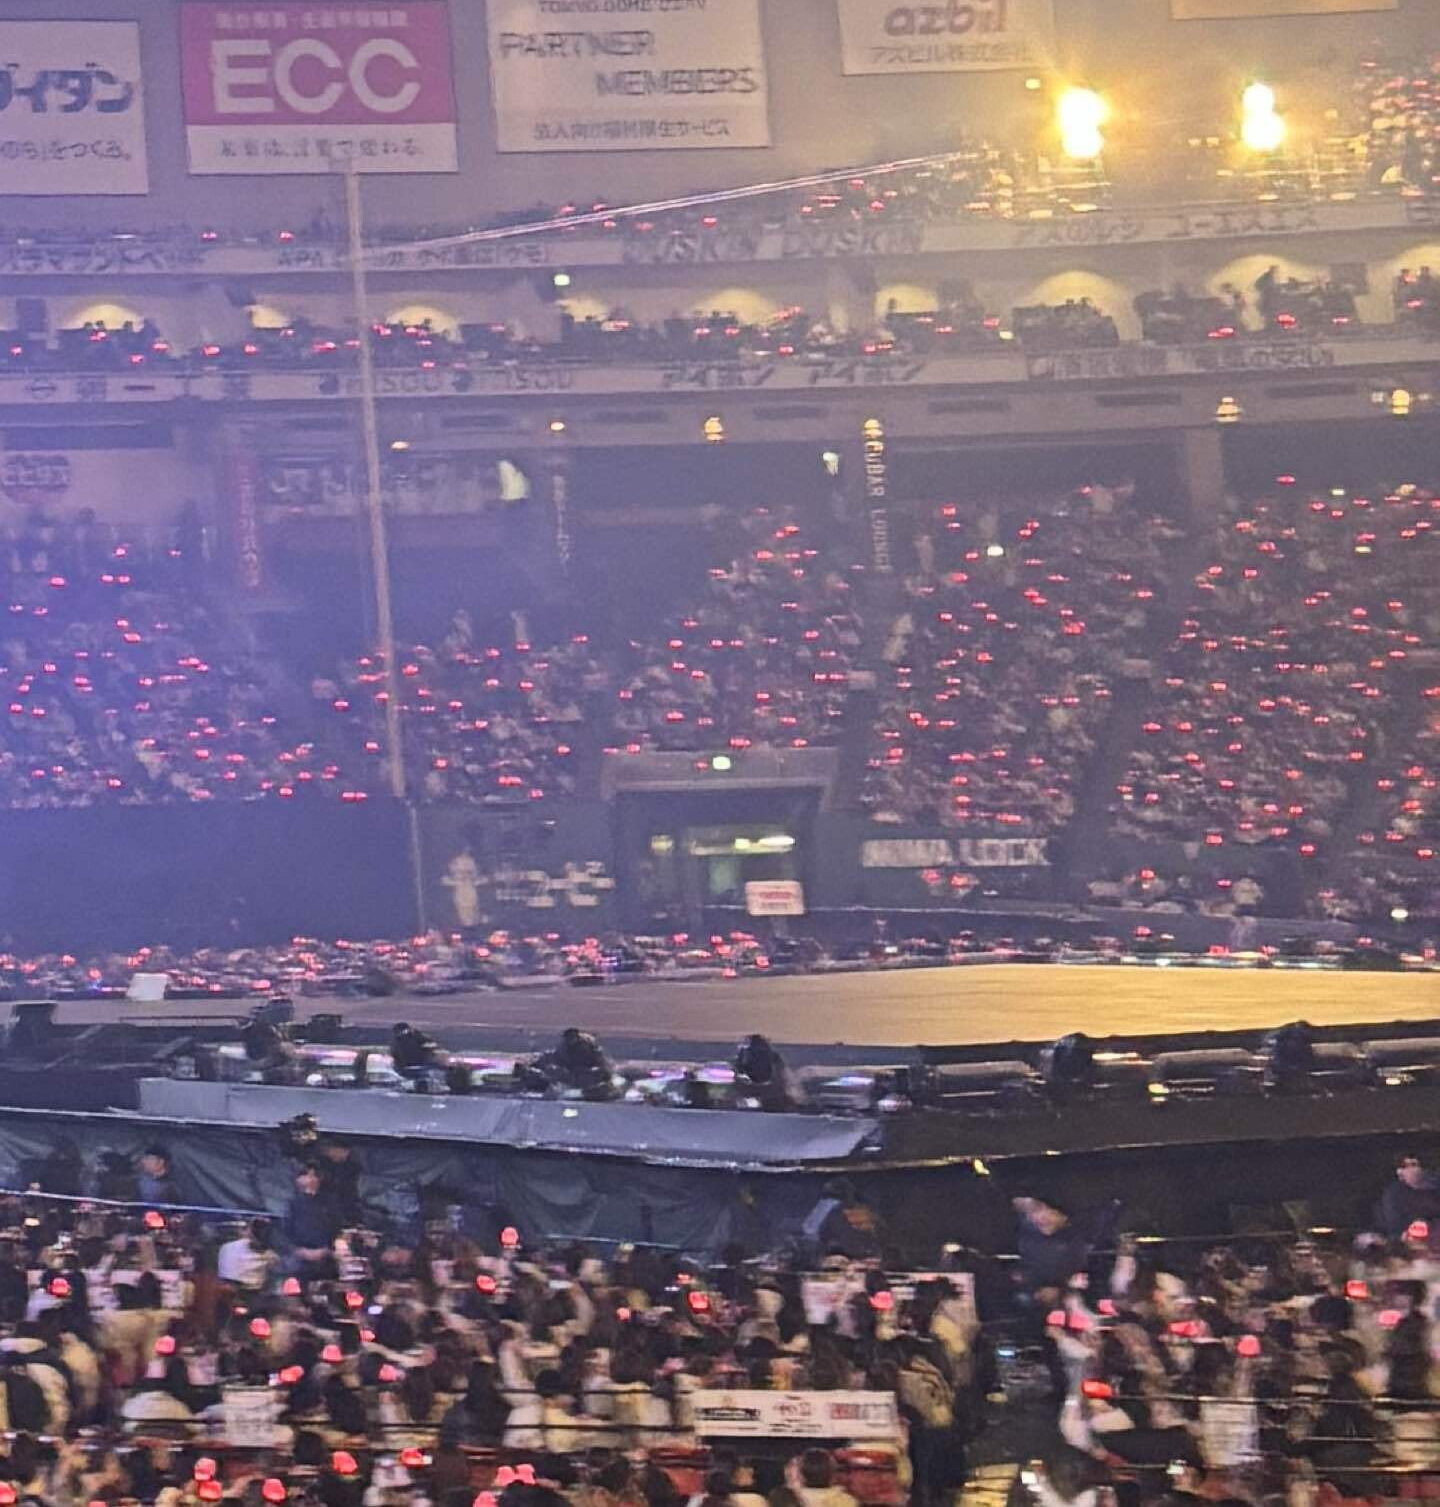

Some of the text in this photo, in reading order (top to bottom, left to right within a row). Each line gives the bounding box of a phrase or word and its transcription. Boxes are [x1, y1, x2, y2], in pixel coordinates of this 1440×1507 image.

[500, 30, 656, 58] PARTNER
[211, 38, 422, 113] ECC
[596, 68, 758, 96] MEMBERS
